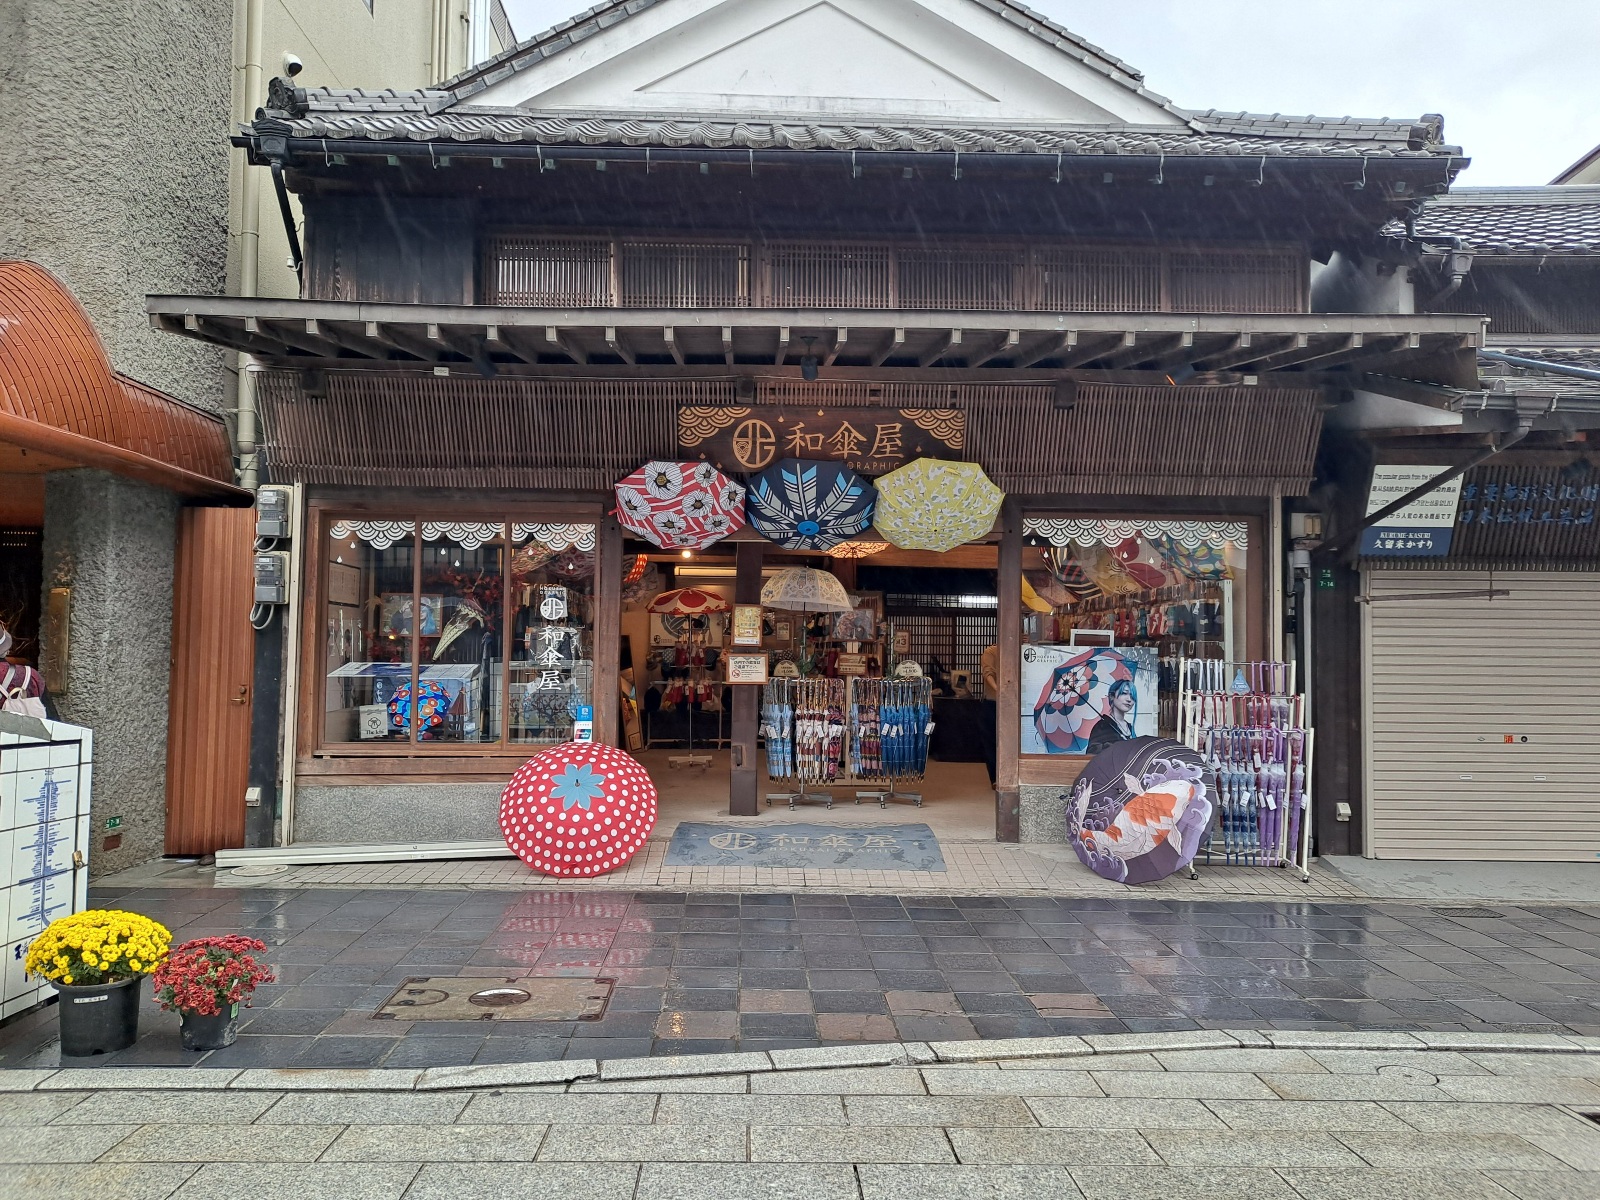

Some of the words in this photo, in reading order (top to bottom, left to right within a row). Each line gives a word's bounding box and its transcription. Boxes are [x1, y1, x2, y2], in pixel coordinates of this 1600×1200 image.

[784, 420, 905, 459] 和傘屋
[1380, 531, 1431, 539] KURUME-KASURI
[1373, 539, 1433, 550] 久留米かすり
[537, 624, 565, 691] 和傘屋
[768, 834, 900, 848] 和傘屋
